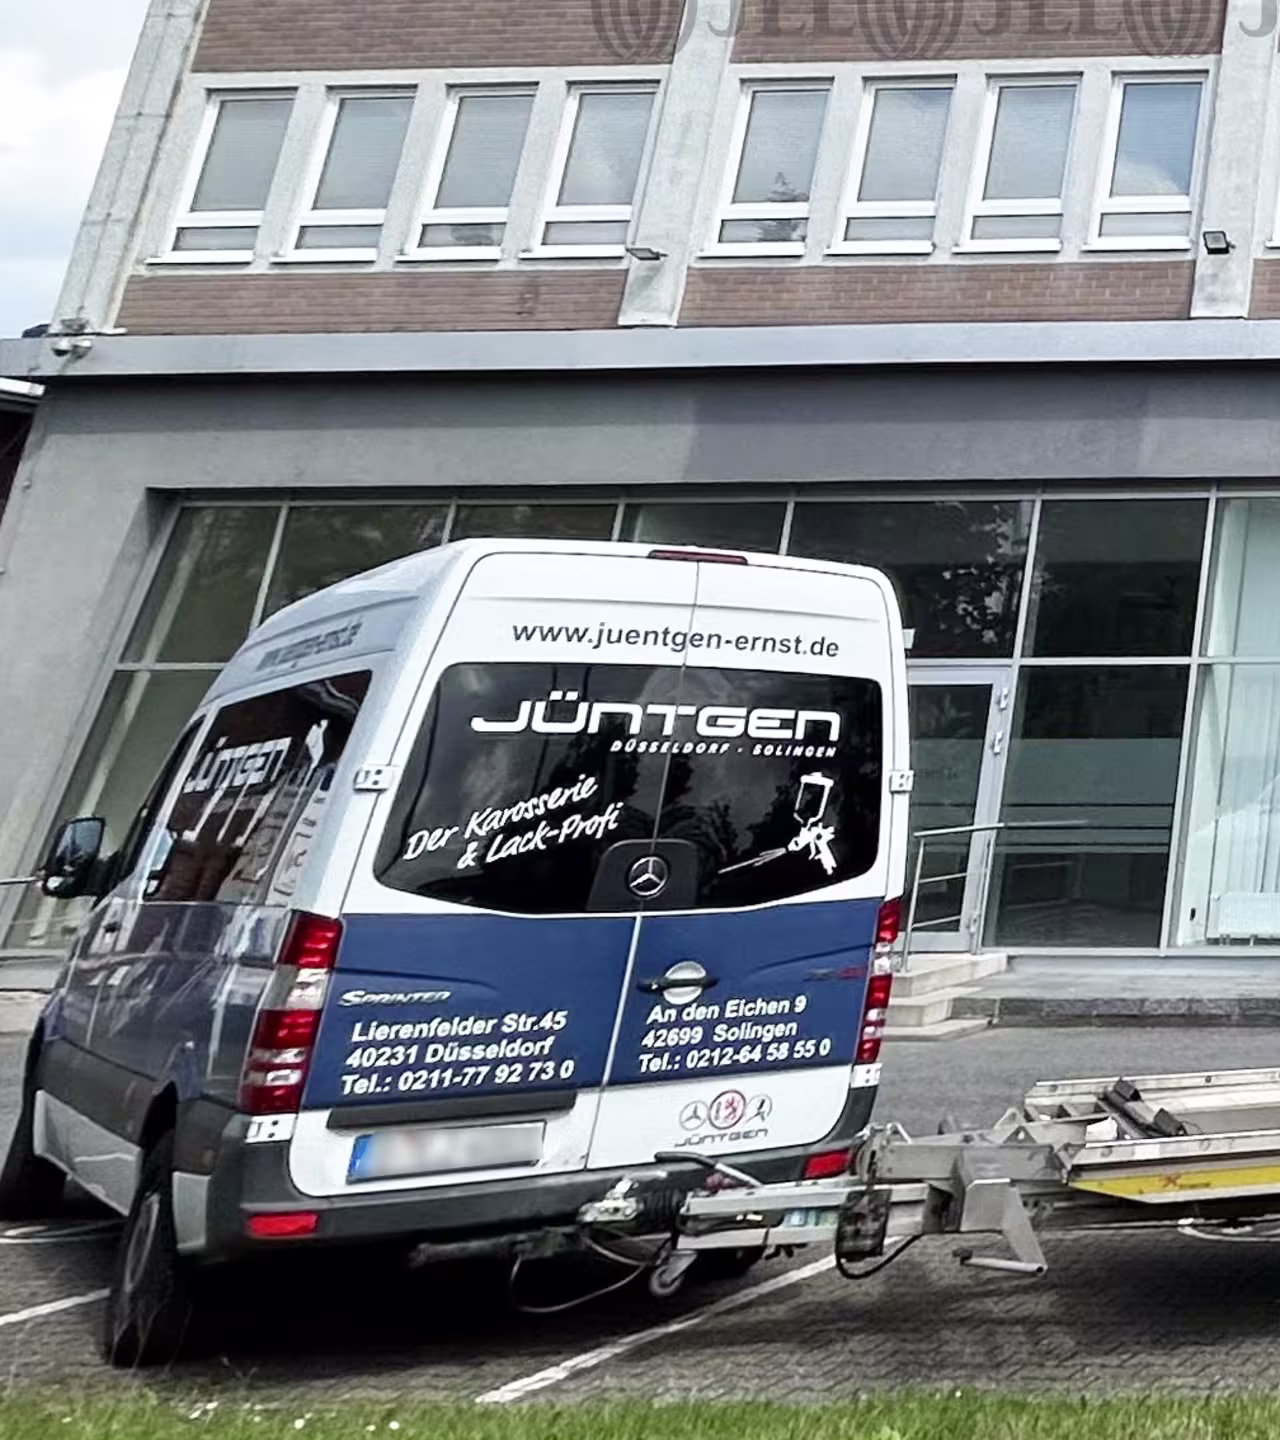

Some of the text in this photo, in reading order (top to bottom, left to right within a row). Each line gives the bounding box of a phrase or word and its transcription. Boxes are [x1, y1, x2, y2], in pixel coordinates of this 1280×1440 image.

[512, 622, 839, 657] www.juentgen-ernst.de
[470, 691, 842, 741] JÜNTGEN
[610, 739, 730, 754] DÜSSELDORF
[752, 744, 837, 757] SOLINGEN
[403, 774, 598, 860] Der Karosserie
[456, 803, 623, 869] & Lack-Profi
[352, 1010, 568, 1042] Lierenfelder Str.45
[646, 995, 807, 1025] An den Eichen 9
[641, 1020, 798, 1048] 42699 Solingen
[345, 1036, 555, 1068] 40231 Düsseldorf
[639, 1038, 831, 1073] Tel.: 0212-64 58 55 0
[341, 1060, 575, 1096] Tel.: 0211-77 92 73 0
[674, 1129, 769, 1148] JÜNTGEN
